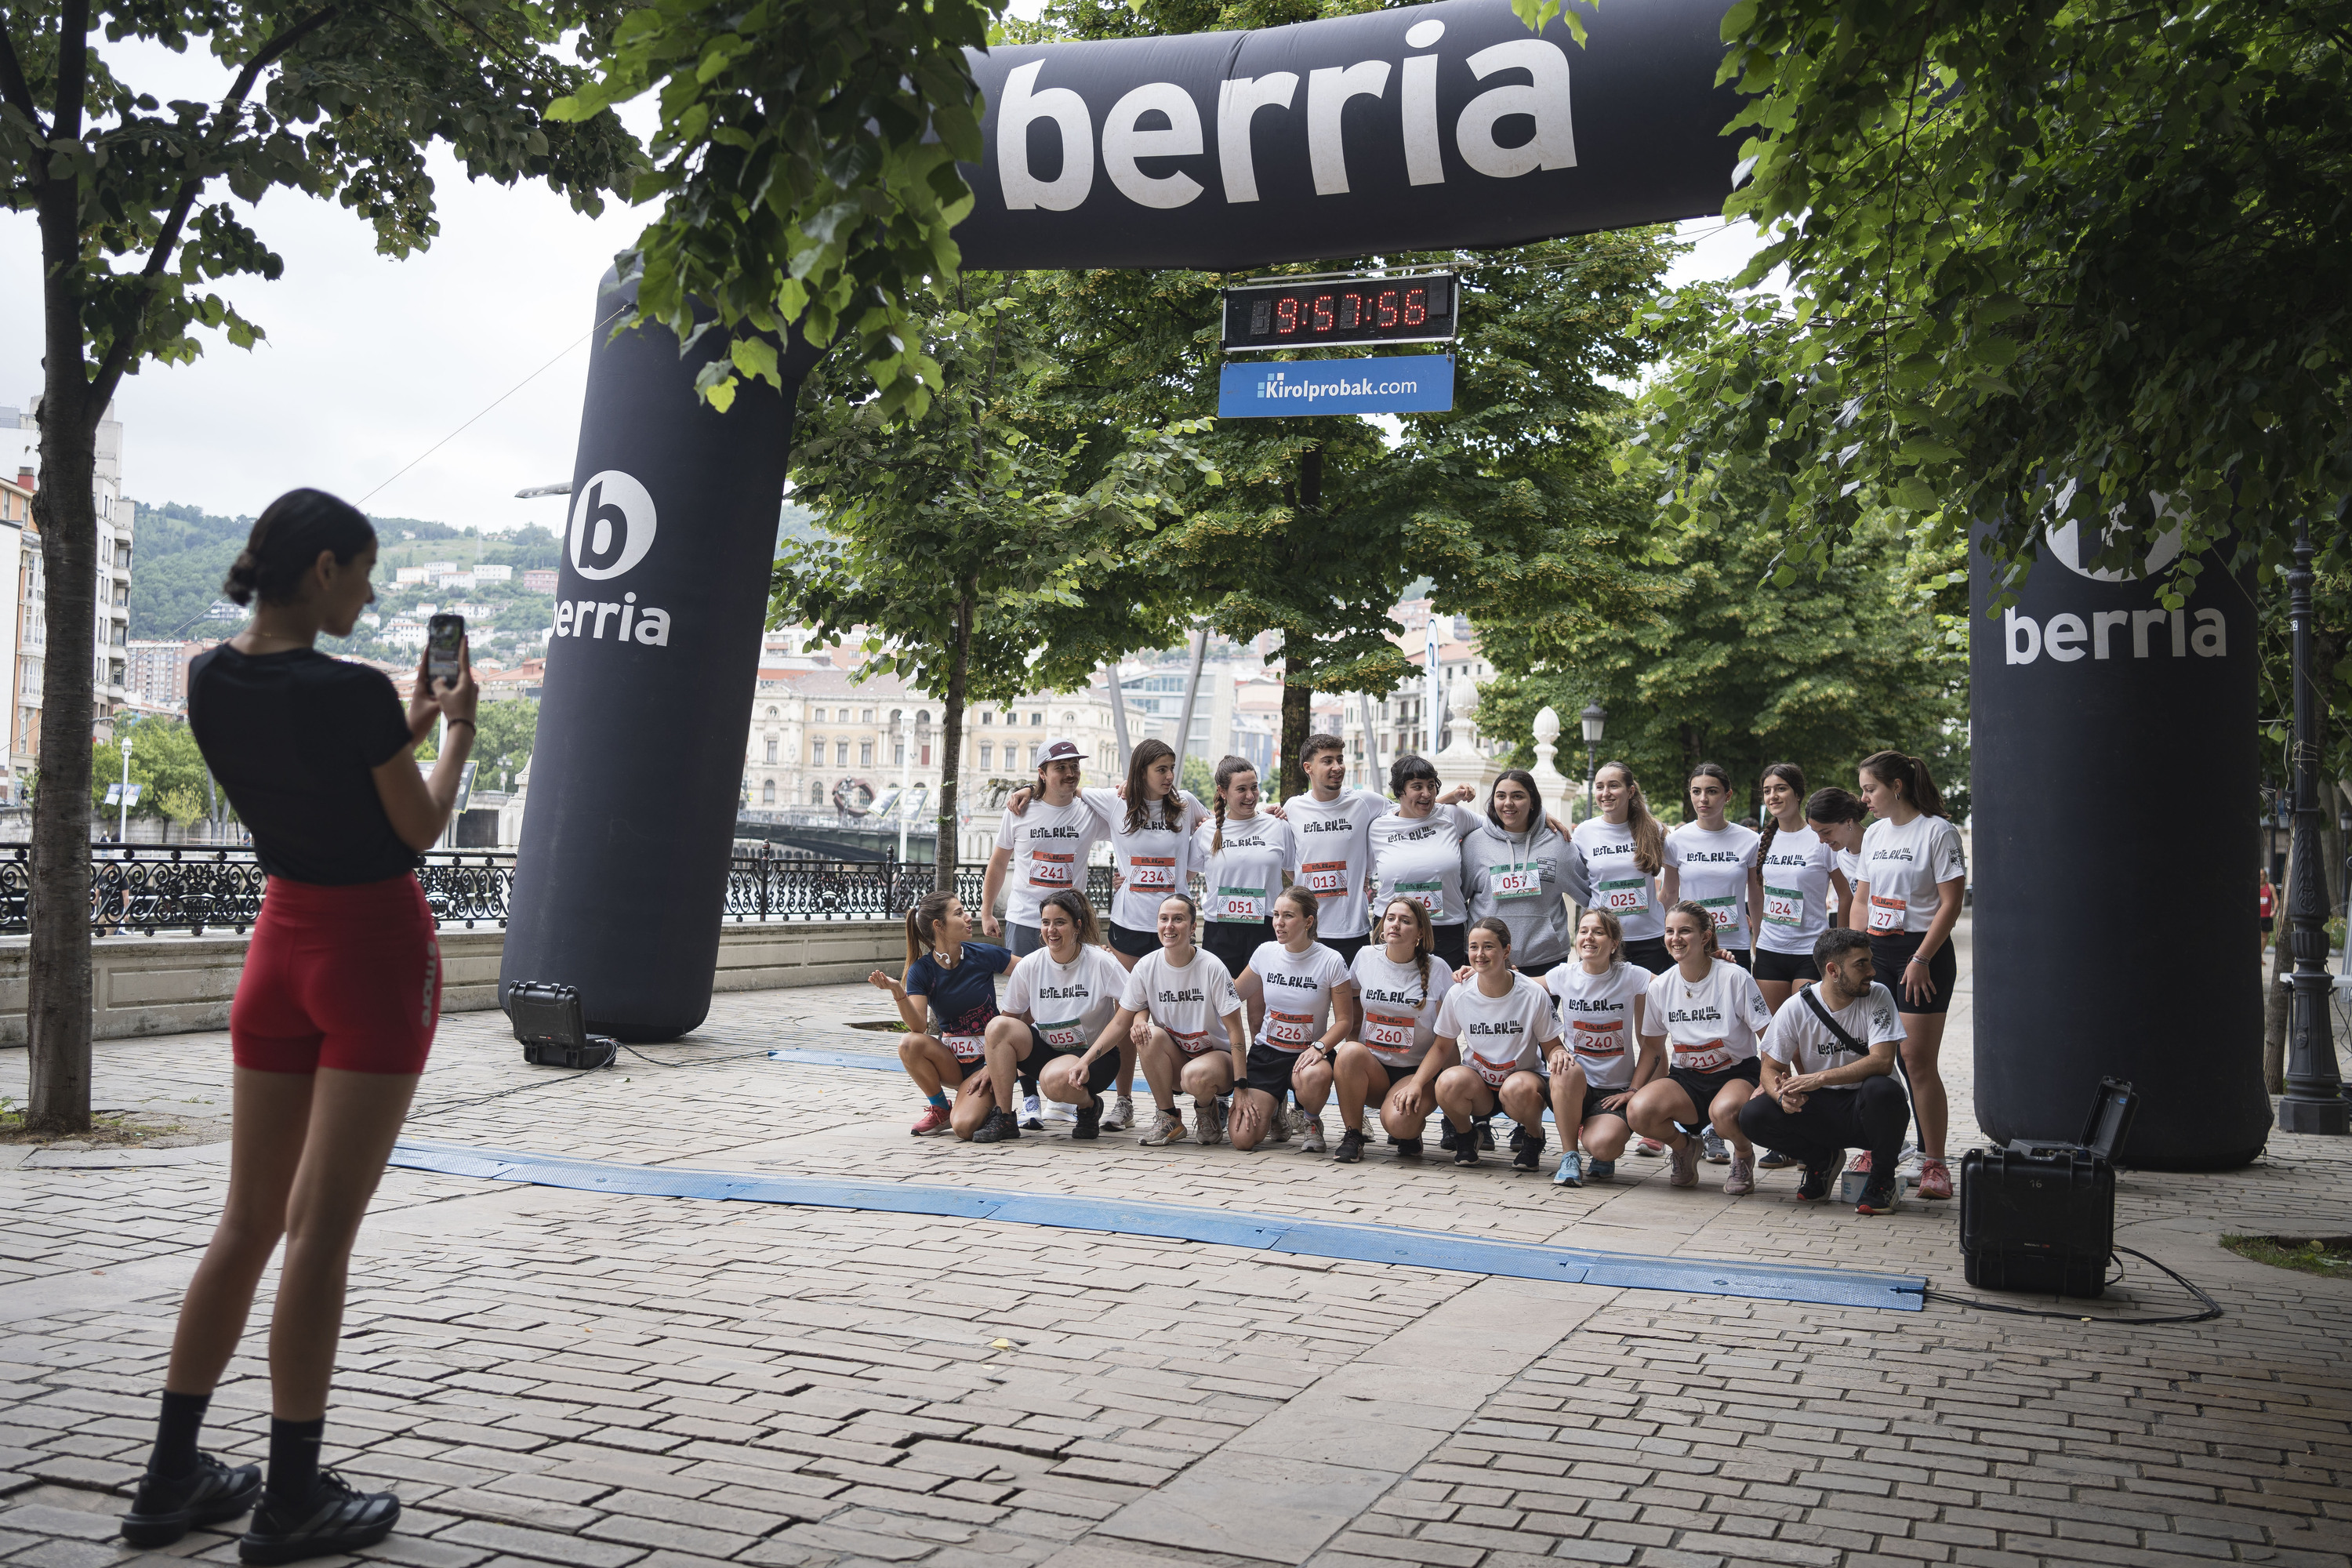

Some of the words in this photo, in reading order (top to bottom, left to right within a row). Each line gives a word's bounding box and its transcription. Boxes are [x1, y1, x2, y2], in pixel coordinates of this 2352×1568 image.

[996, 19, 1578, 212] berria
[1278, 289, 1425, 334] 9:57:56
[1265, 378, 1417, 402] Kirolprobak.com
[2004, 605, 2227, 666] berria
[1040, 866, 1064, 879] 241
[1140, 870, 1165, 884] 234
[1312, 875, 1337, 889] 013
[1610, 892, 1637, 907] 025
[1228, 900, 1254, 914] 051
[1769, 901, 1791, 916] 024
[1711, 910, 1728, 924] 26
[1875, 912, 1892, 927] 27
[1049, 1031, 1074, 1044] 055
[1276, 1025, 1301, 1040] 226
[1376, 1028, 1403, 1044] 260
[951, 1040, 975, 1054] 054
[1585, 1036, 1613, 1049] 240
[1690, 1054, 1719, 1068] 211
[1482, 1070, 1506, 1083] 194
[2029, 1179, 2042, 1189] 16
